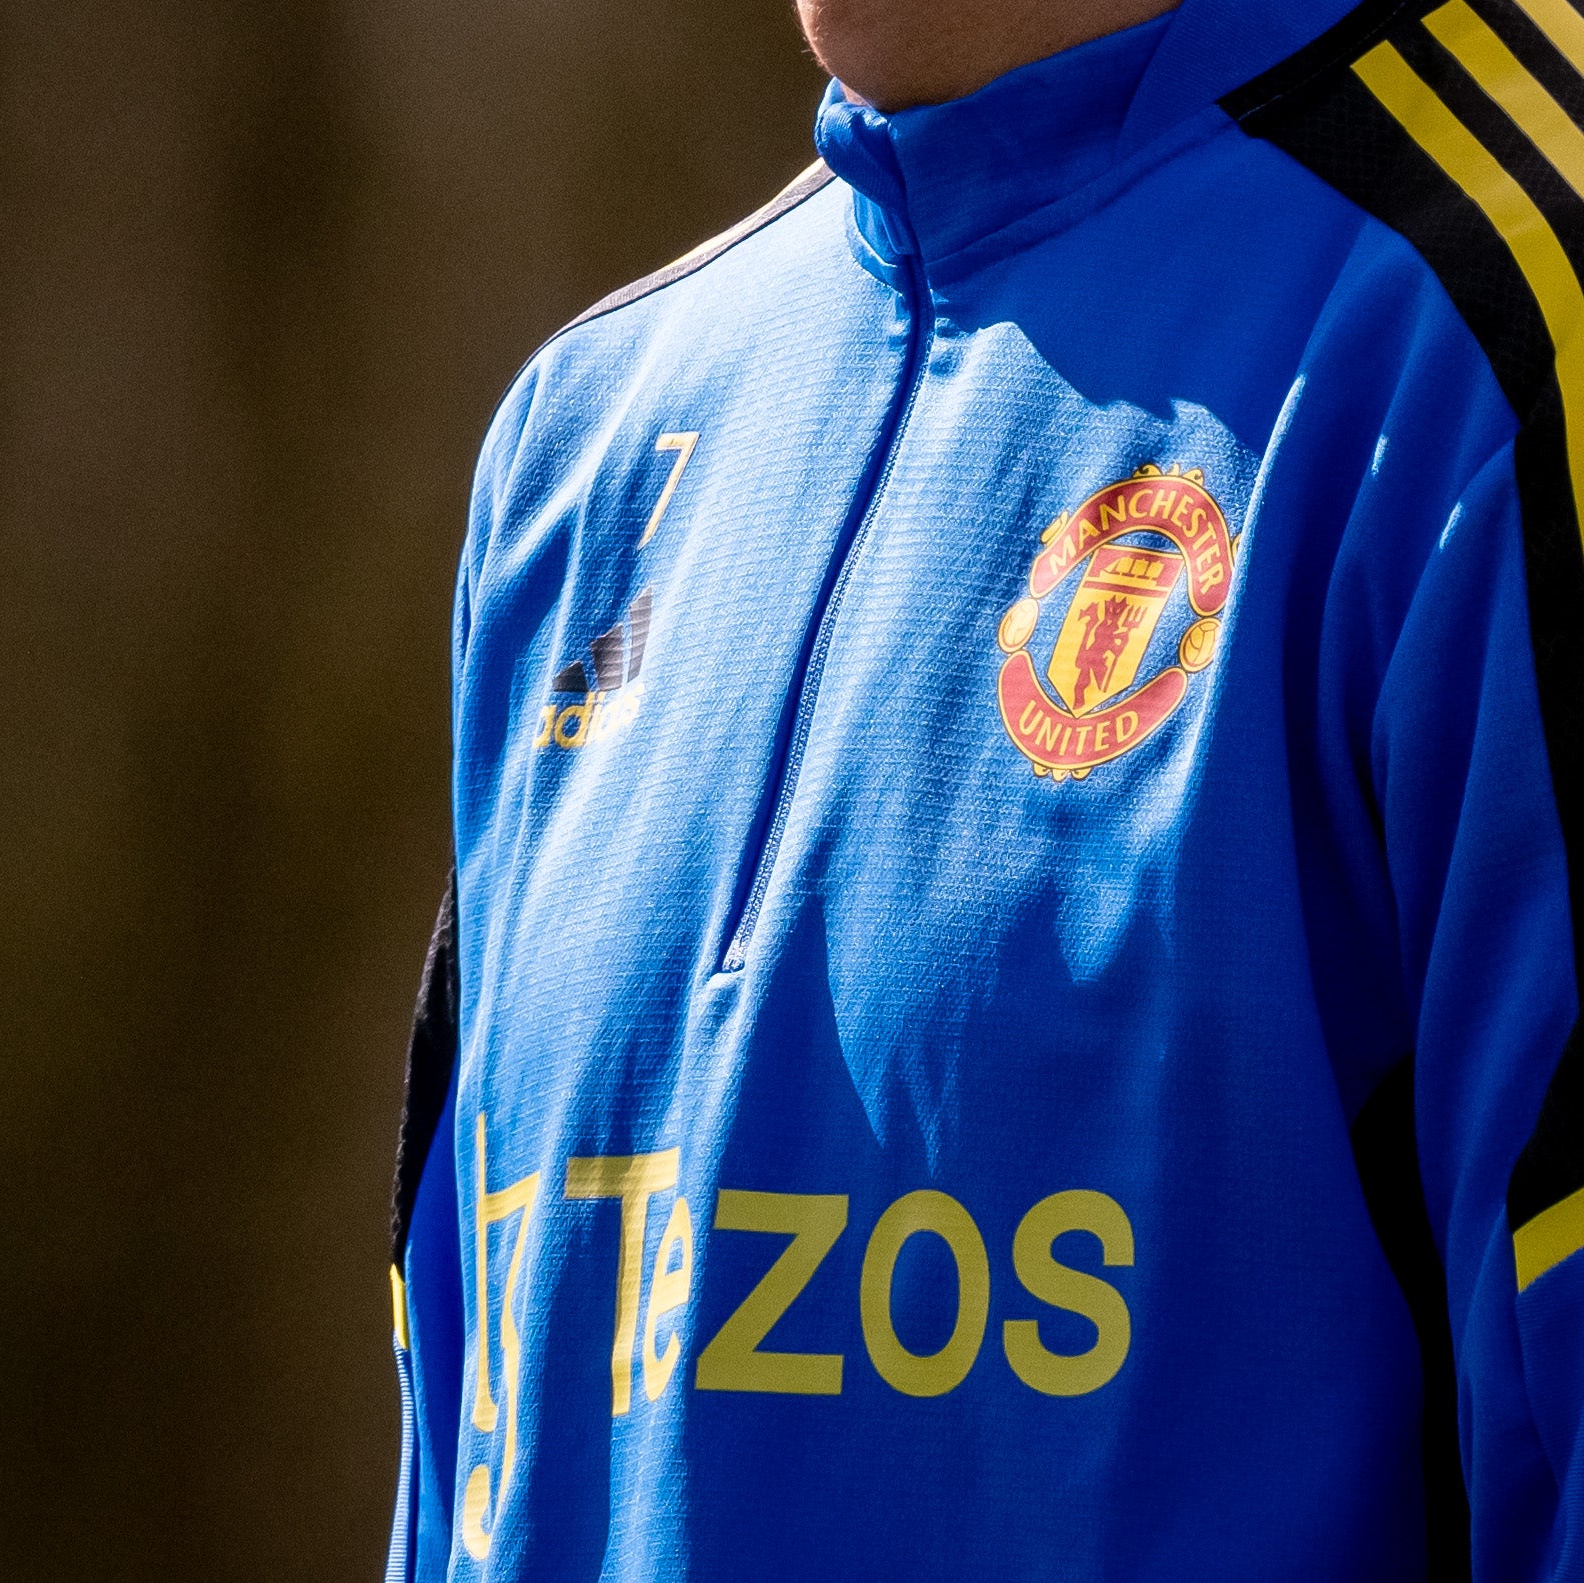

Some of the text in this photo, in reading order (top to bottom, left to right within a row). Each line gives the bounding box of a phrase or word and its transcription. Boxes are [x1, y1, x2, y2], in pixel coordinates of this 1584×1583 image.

[635, 431, 700, 550] 7
[1048, 488, 1223, 595] MANCHESTER
[532, 683, 645, 748] adi
[1018, 699, 1140, 756] UNITED
[564, 1147, 1136, 1417] Tezos
